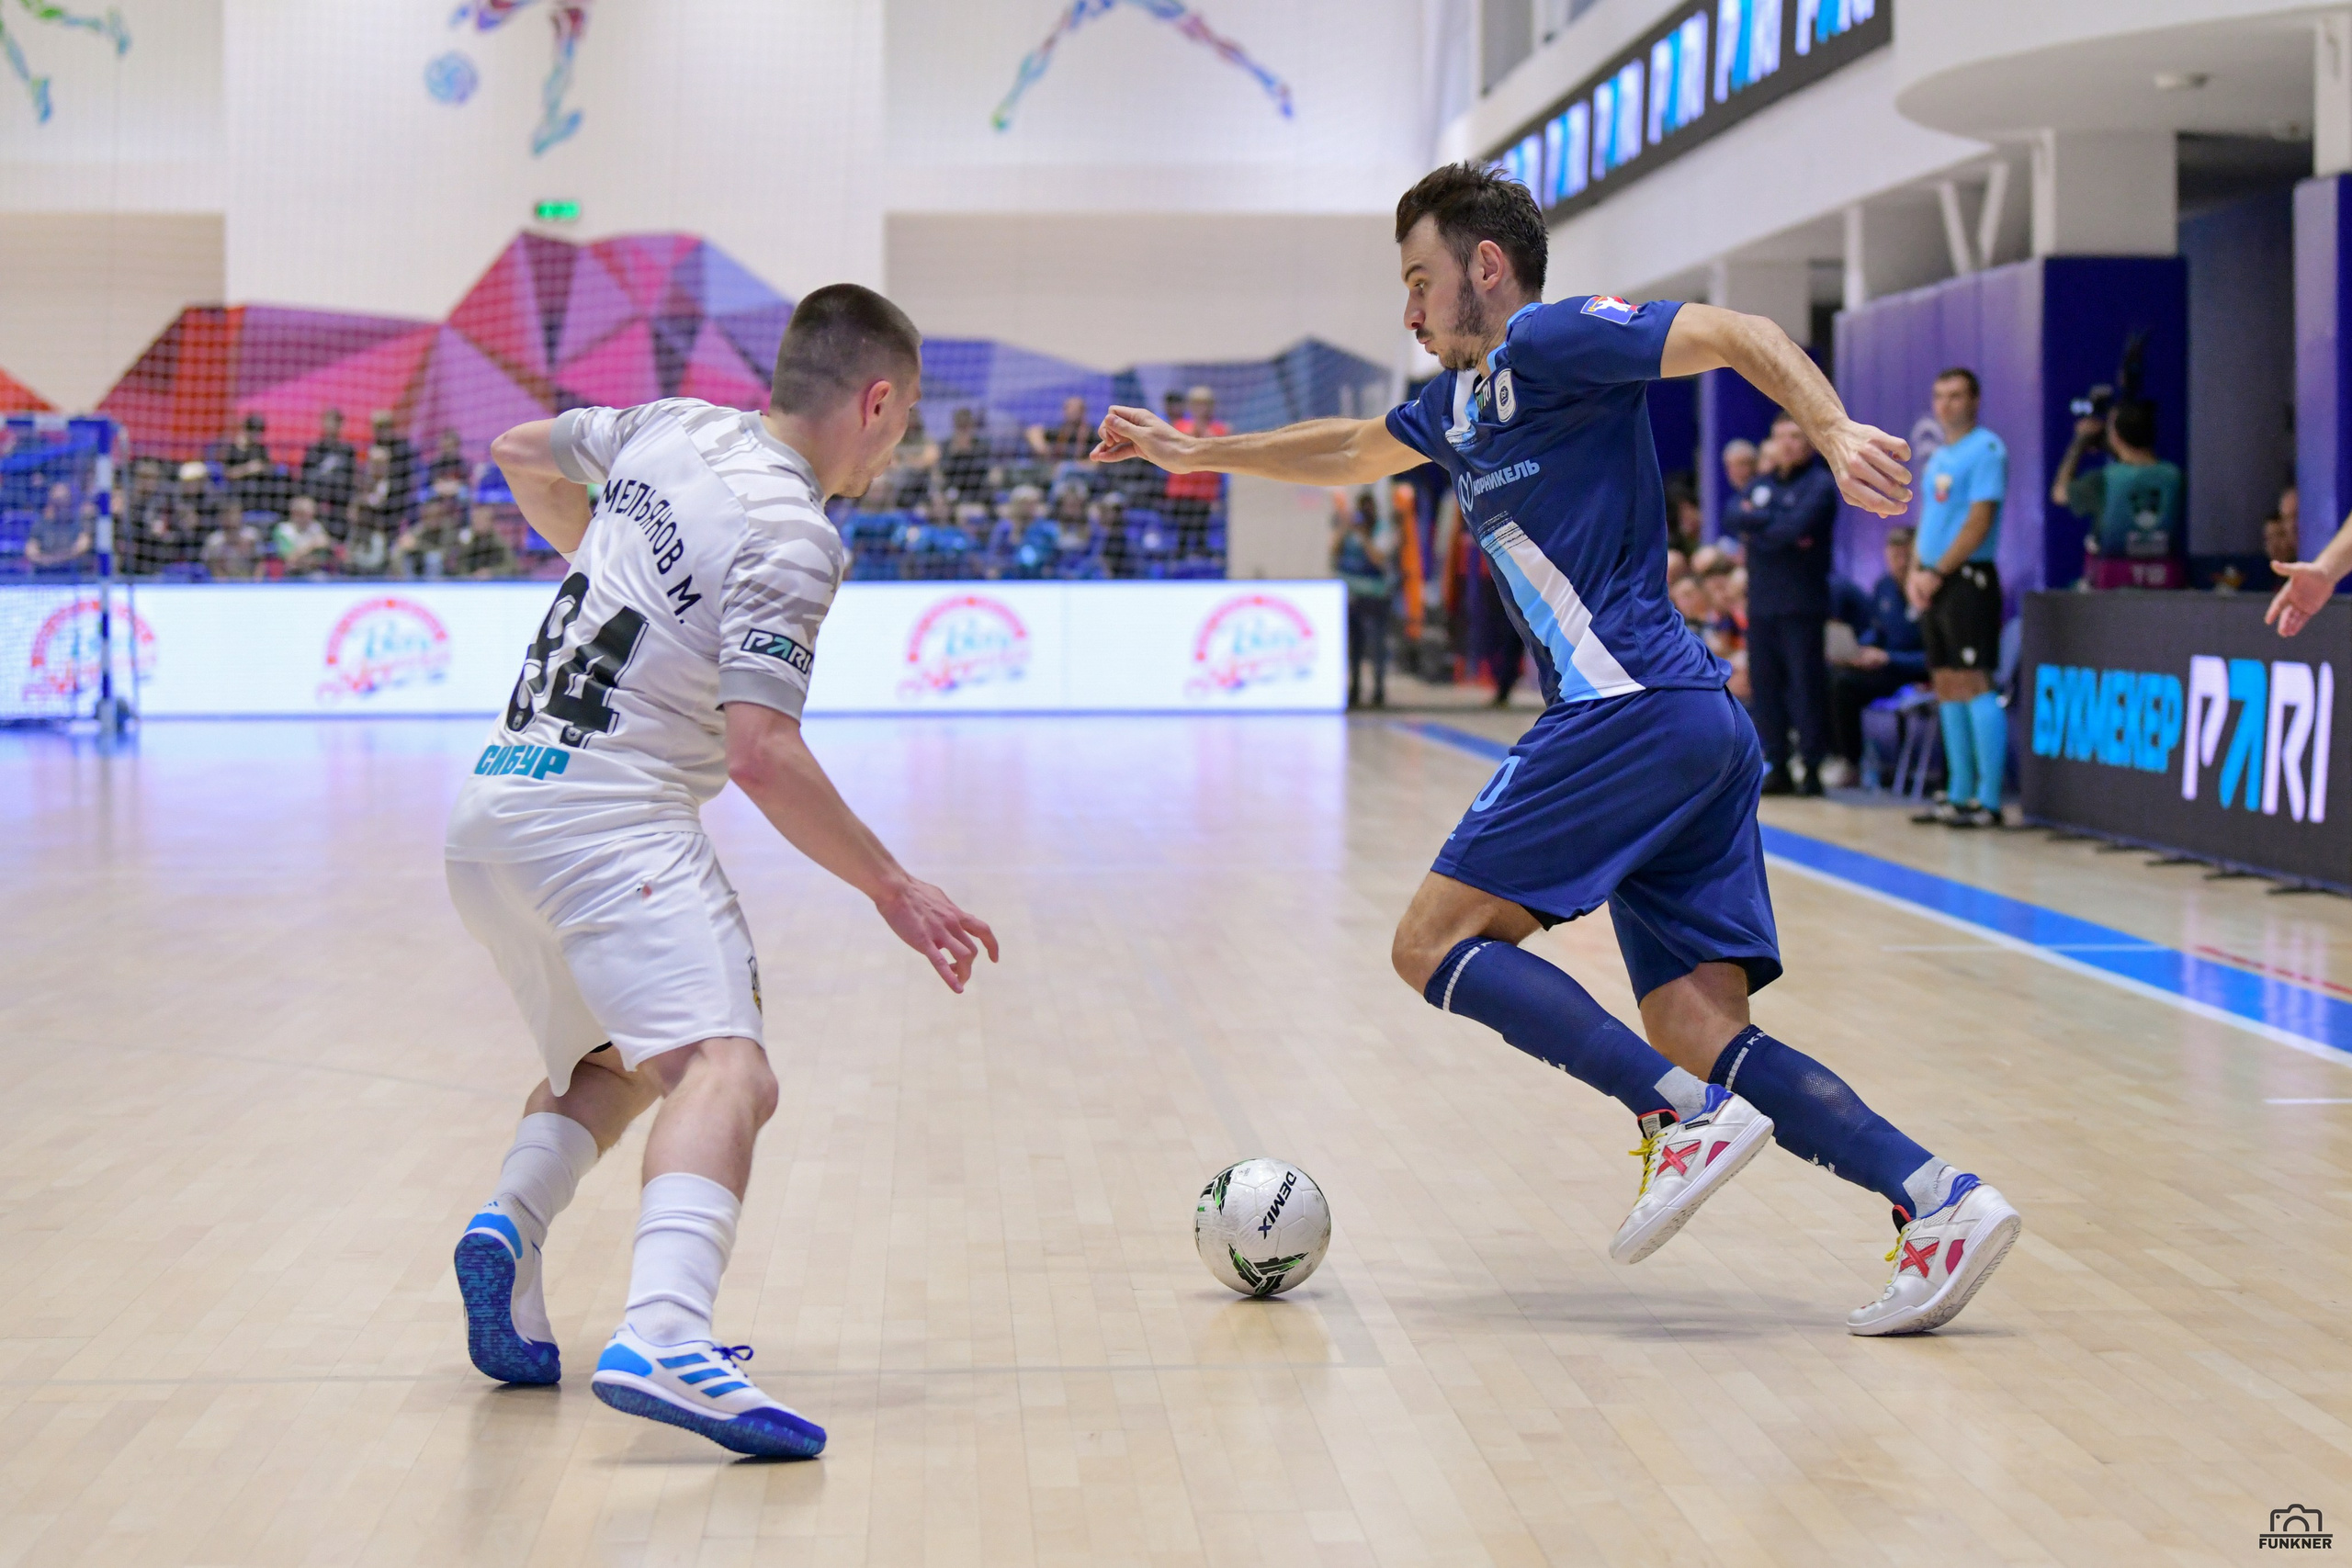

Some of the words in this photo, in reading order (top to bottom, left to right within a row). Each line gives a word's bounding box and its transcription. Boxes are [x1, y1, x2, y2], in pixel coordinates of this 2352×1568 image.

[1473, 459, 1541, 497] НОРНИКЕЛЬ
[593, 479, 684, 575] МЕЛЬЯНОВ
[505, 571, 650, 749] 84
[742, 630, 811, 672] PARI
[474, 745, 571, 780] СИБУР
[2031, 662, 2183, 774] БУКМЕКЕР
[2181, 654, 2335, 824] PARI
[1258, 1170, 1297, 1240] DEMIX
